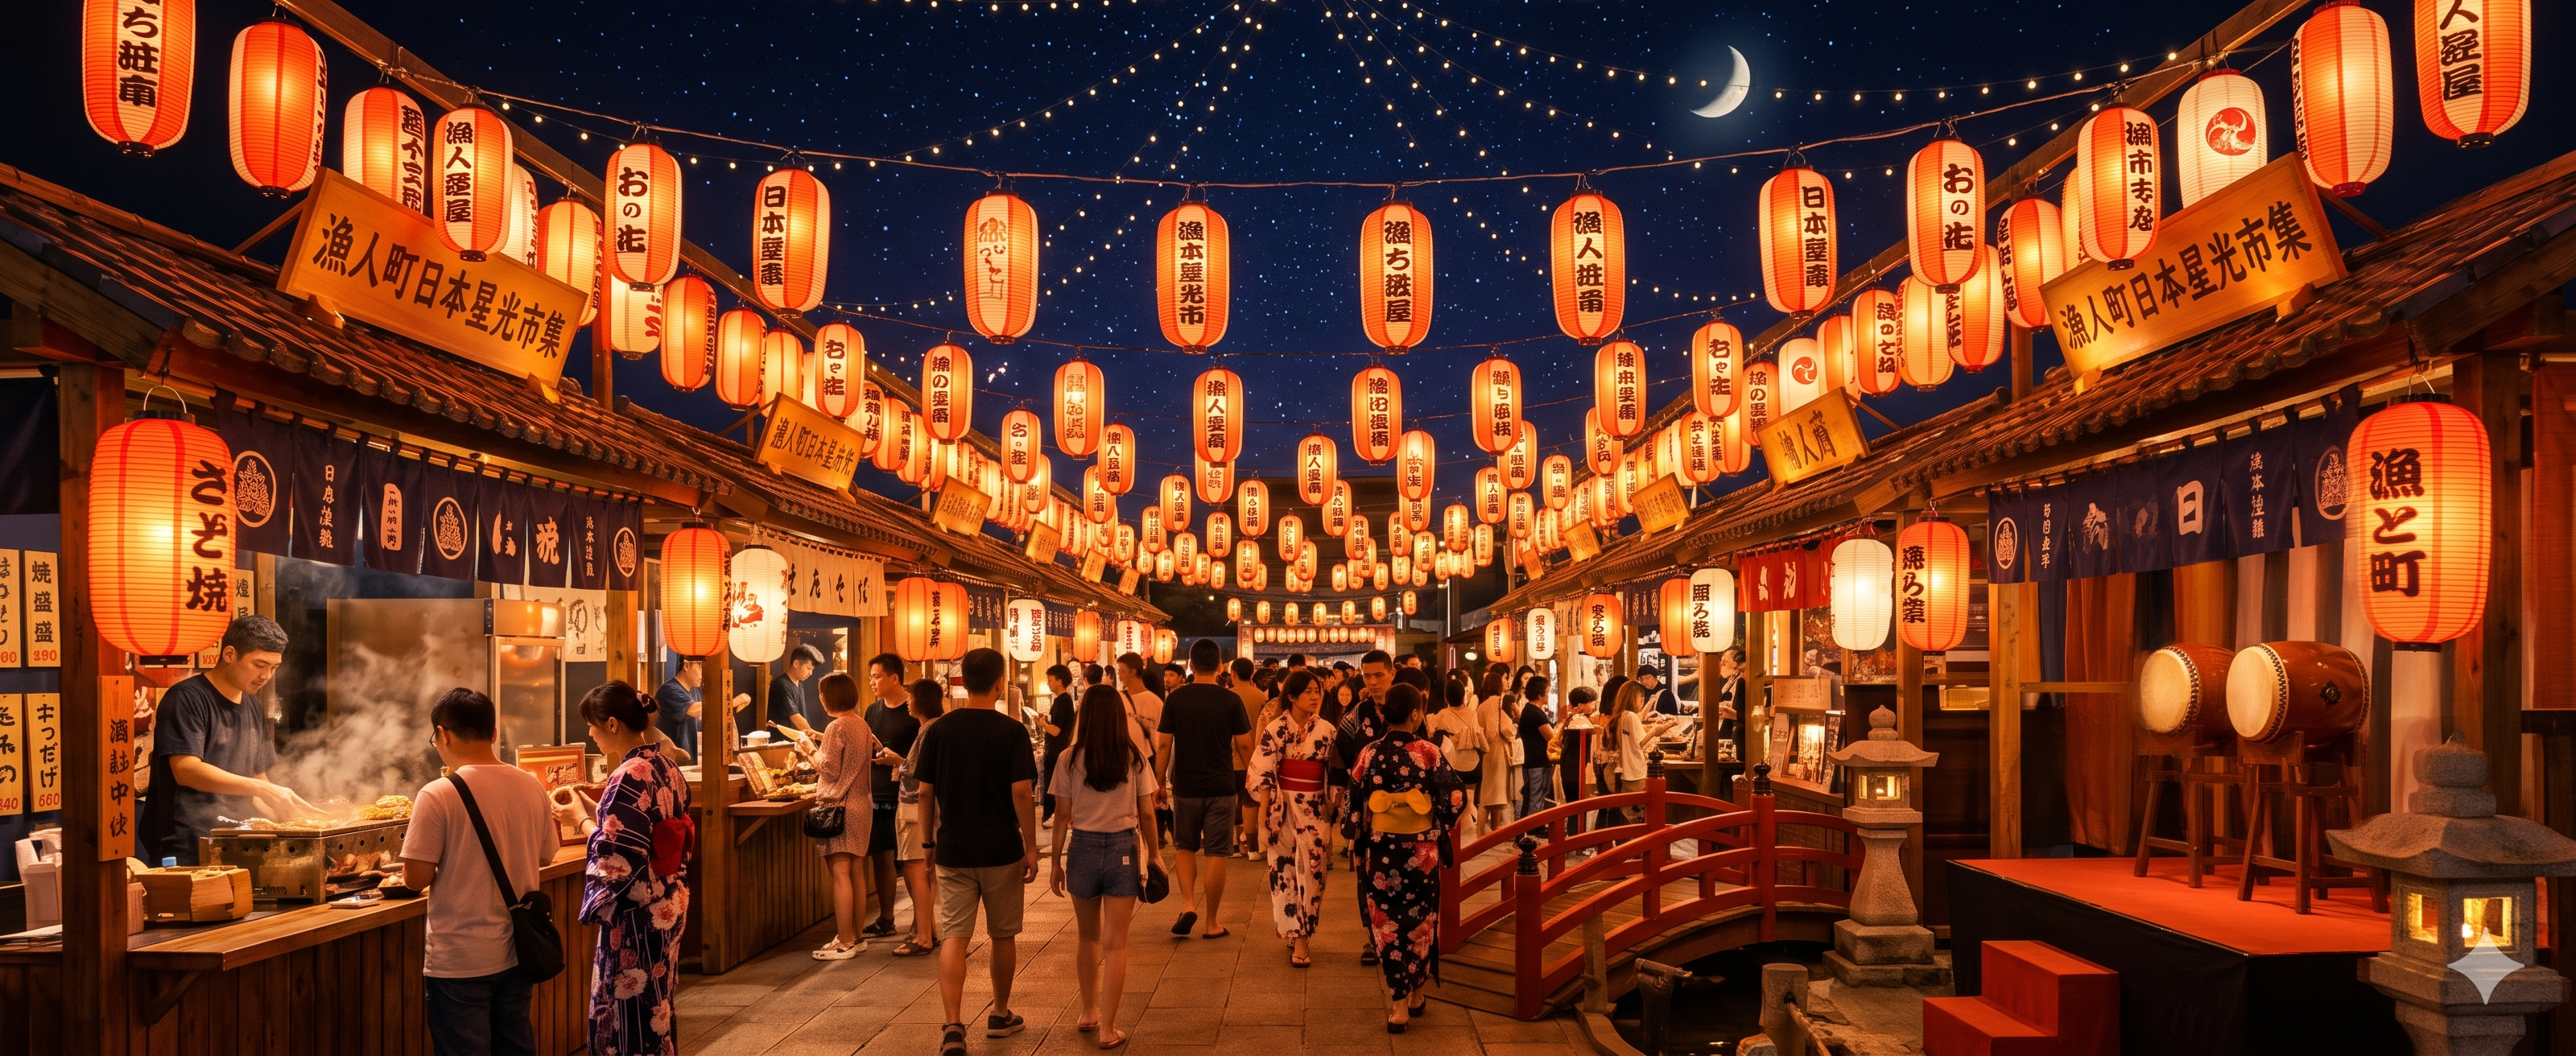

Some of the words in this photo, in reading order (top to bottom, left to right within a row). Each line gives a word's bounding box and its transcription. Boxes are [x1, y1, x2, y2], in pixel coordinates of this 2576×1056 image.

[312, 212, 567, 360] 漁人町日本星光市集
[2058, 200, 2313, 351] 漁人町日本星光市集
[2369, 448, 2427, 597] 漁と町
[31, 560, 54, 643] 焼盛盛
[39, 792, 60, 807] 660
